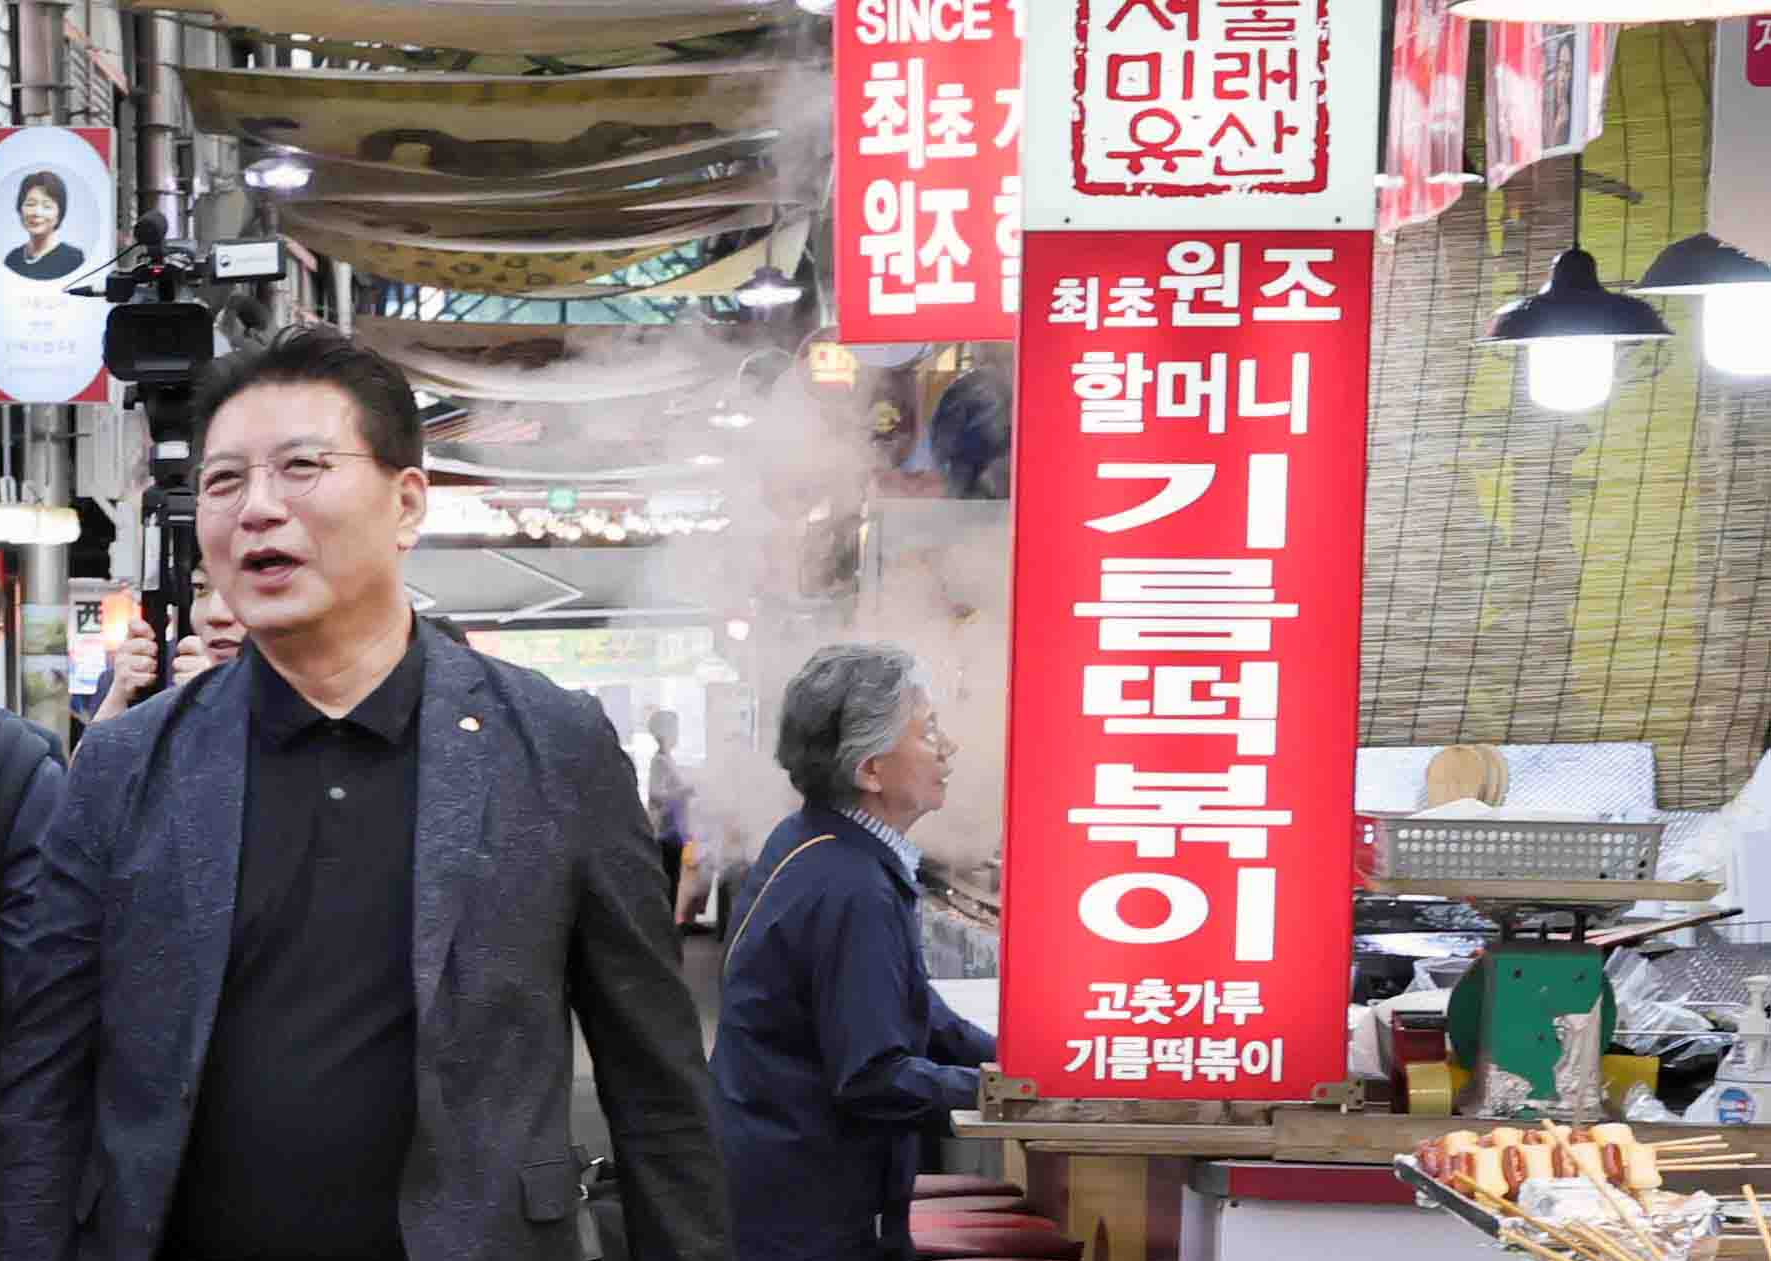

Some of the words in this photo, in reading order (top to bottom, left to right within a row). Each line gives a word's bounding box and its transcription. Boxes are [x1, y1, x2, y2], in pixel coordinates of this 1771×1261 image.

[859, 58, 978, 170] 최초
[1106, 48, 1298, 102] 미래
[1106, 107, 1299, 175] 유산
[859, 178, 976, 315] 원조
[1048, 276, 1159, 331] 최초
[1159, 241, 1342, 328] 원조
[1071, 351, 1310, 434] 할머니
[1068, 453, 1299, 962] 기름떡볶이
[1084, 978, 1265, 1027] 고춧가루
[1064, 1035, 1284, 1083] 기름떡볶이
